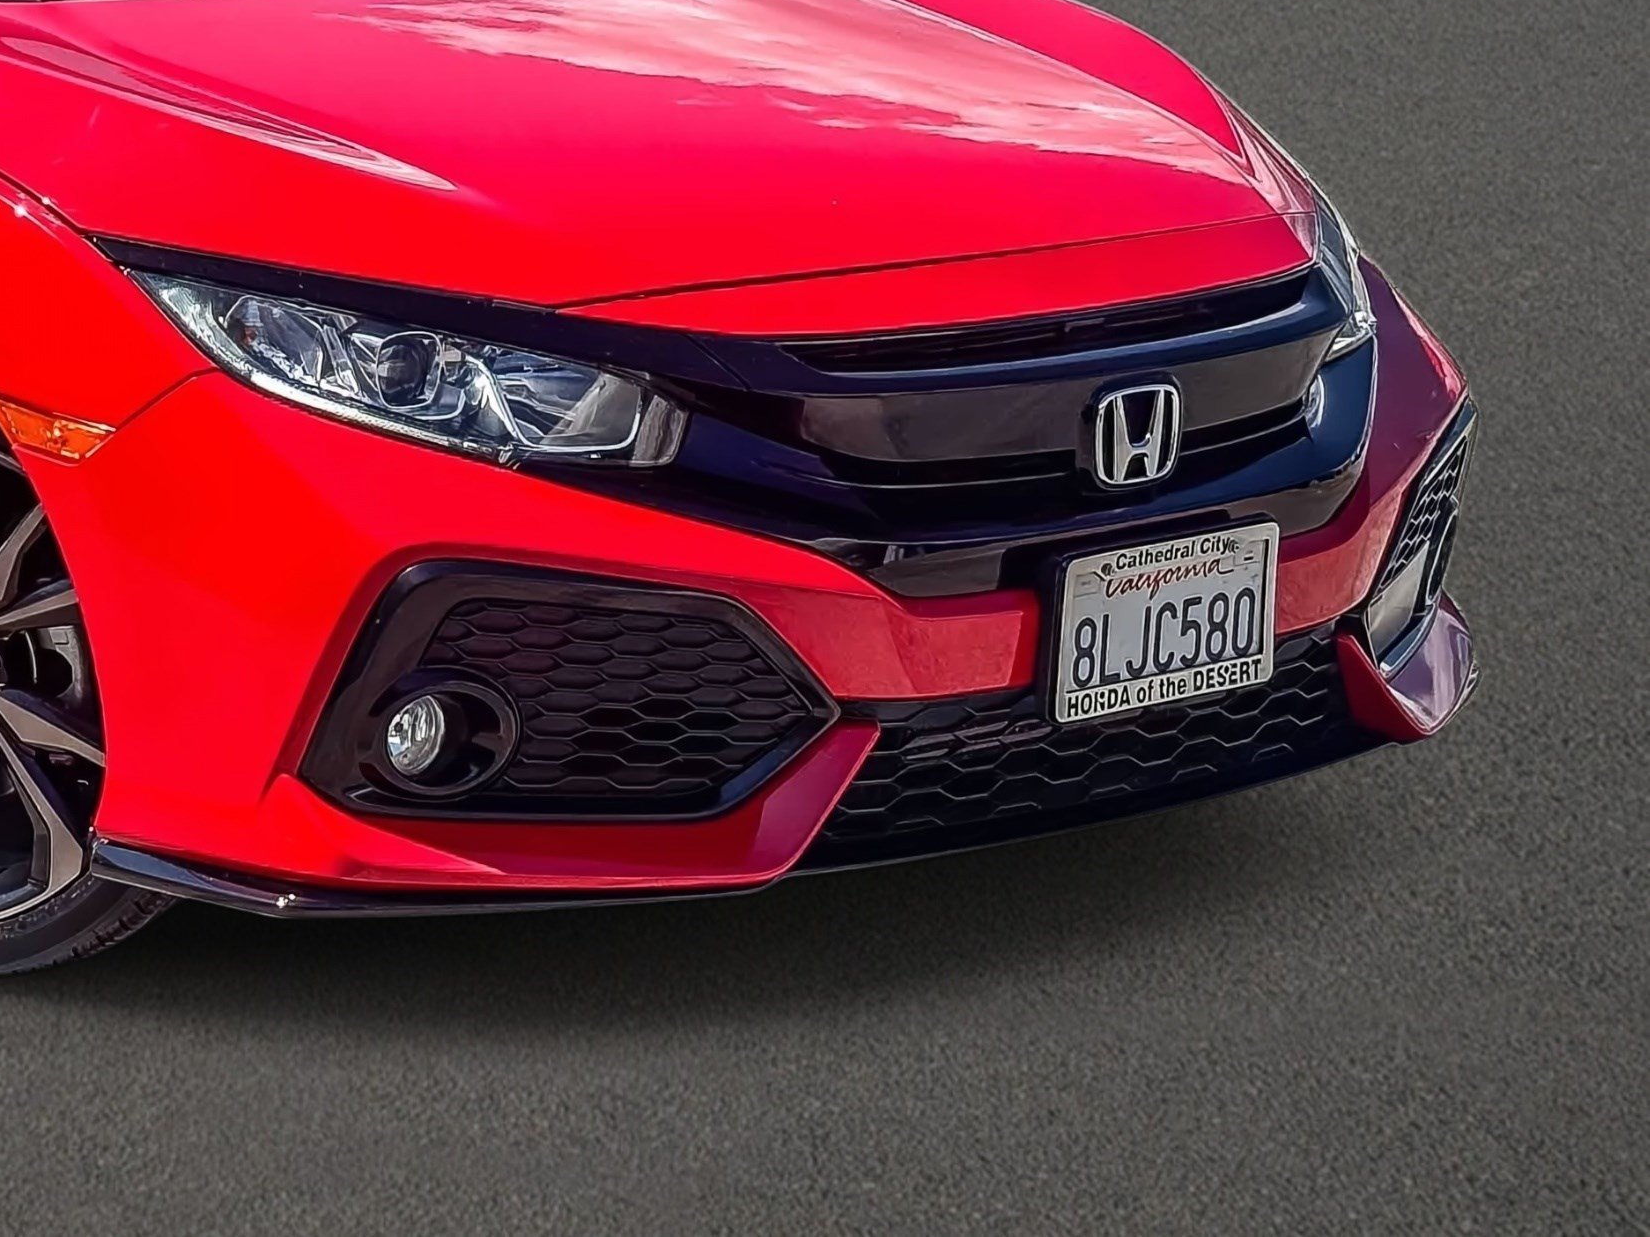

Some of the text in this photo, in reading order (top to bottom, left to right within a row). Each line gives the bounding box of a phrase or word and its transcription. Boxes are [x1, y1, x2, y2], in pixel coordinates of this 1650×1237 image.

[1115, 535, 1230, 571] Cathedral City
[1104, 558, 1235, 600] California
[1071, 586, 1257, 689] 8LJC580
[1066, 658, 1262, 718] HONDA of the DESERT
